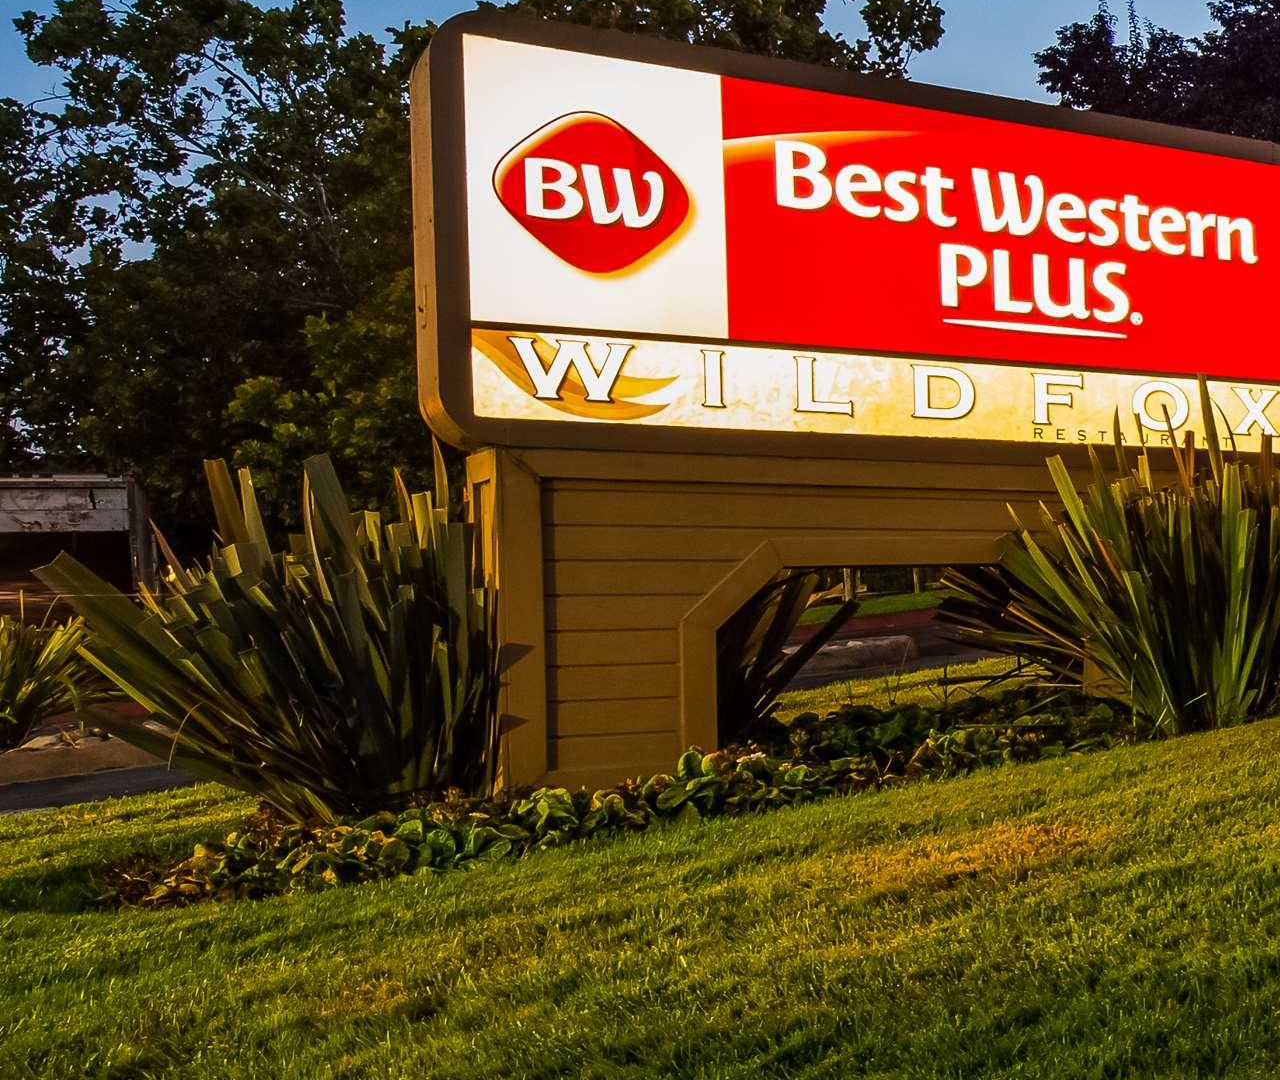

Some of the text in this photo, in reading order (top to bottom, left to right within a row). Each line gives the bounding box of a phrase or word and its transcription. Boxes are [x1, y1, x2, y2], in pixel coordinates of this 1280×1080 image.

[523, 157, 665, 230] BW
[774, 139, 1259, 265] Best Western
